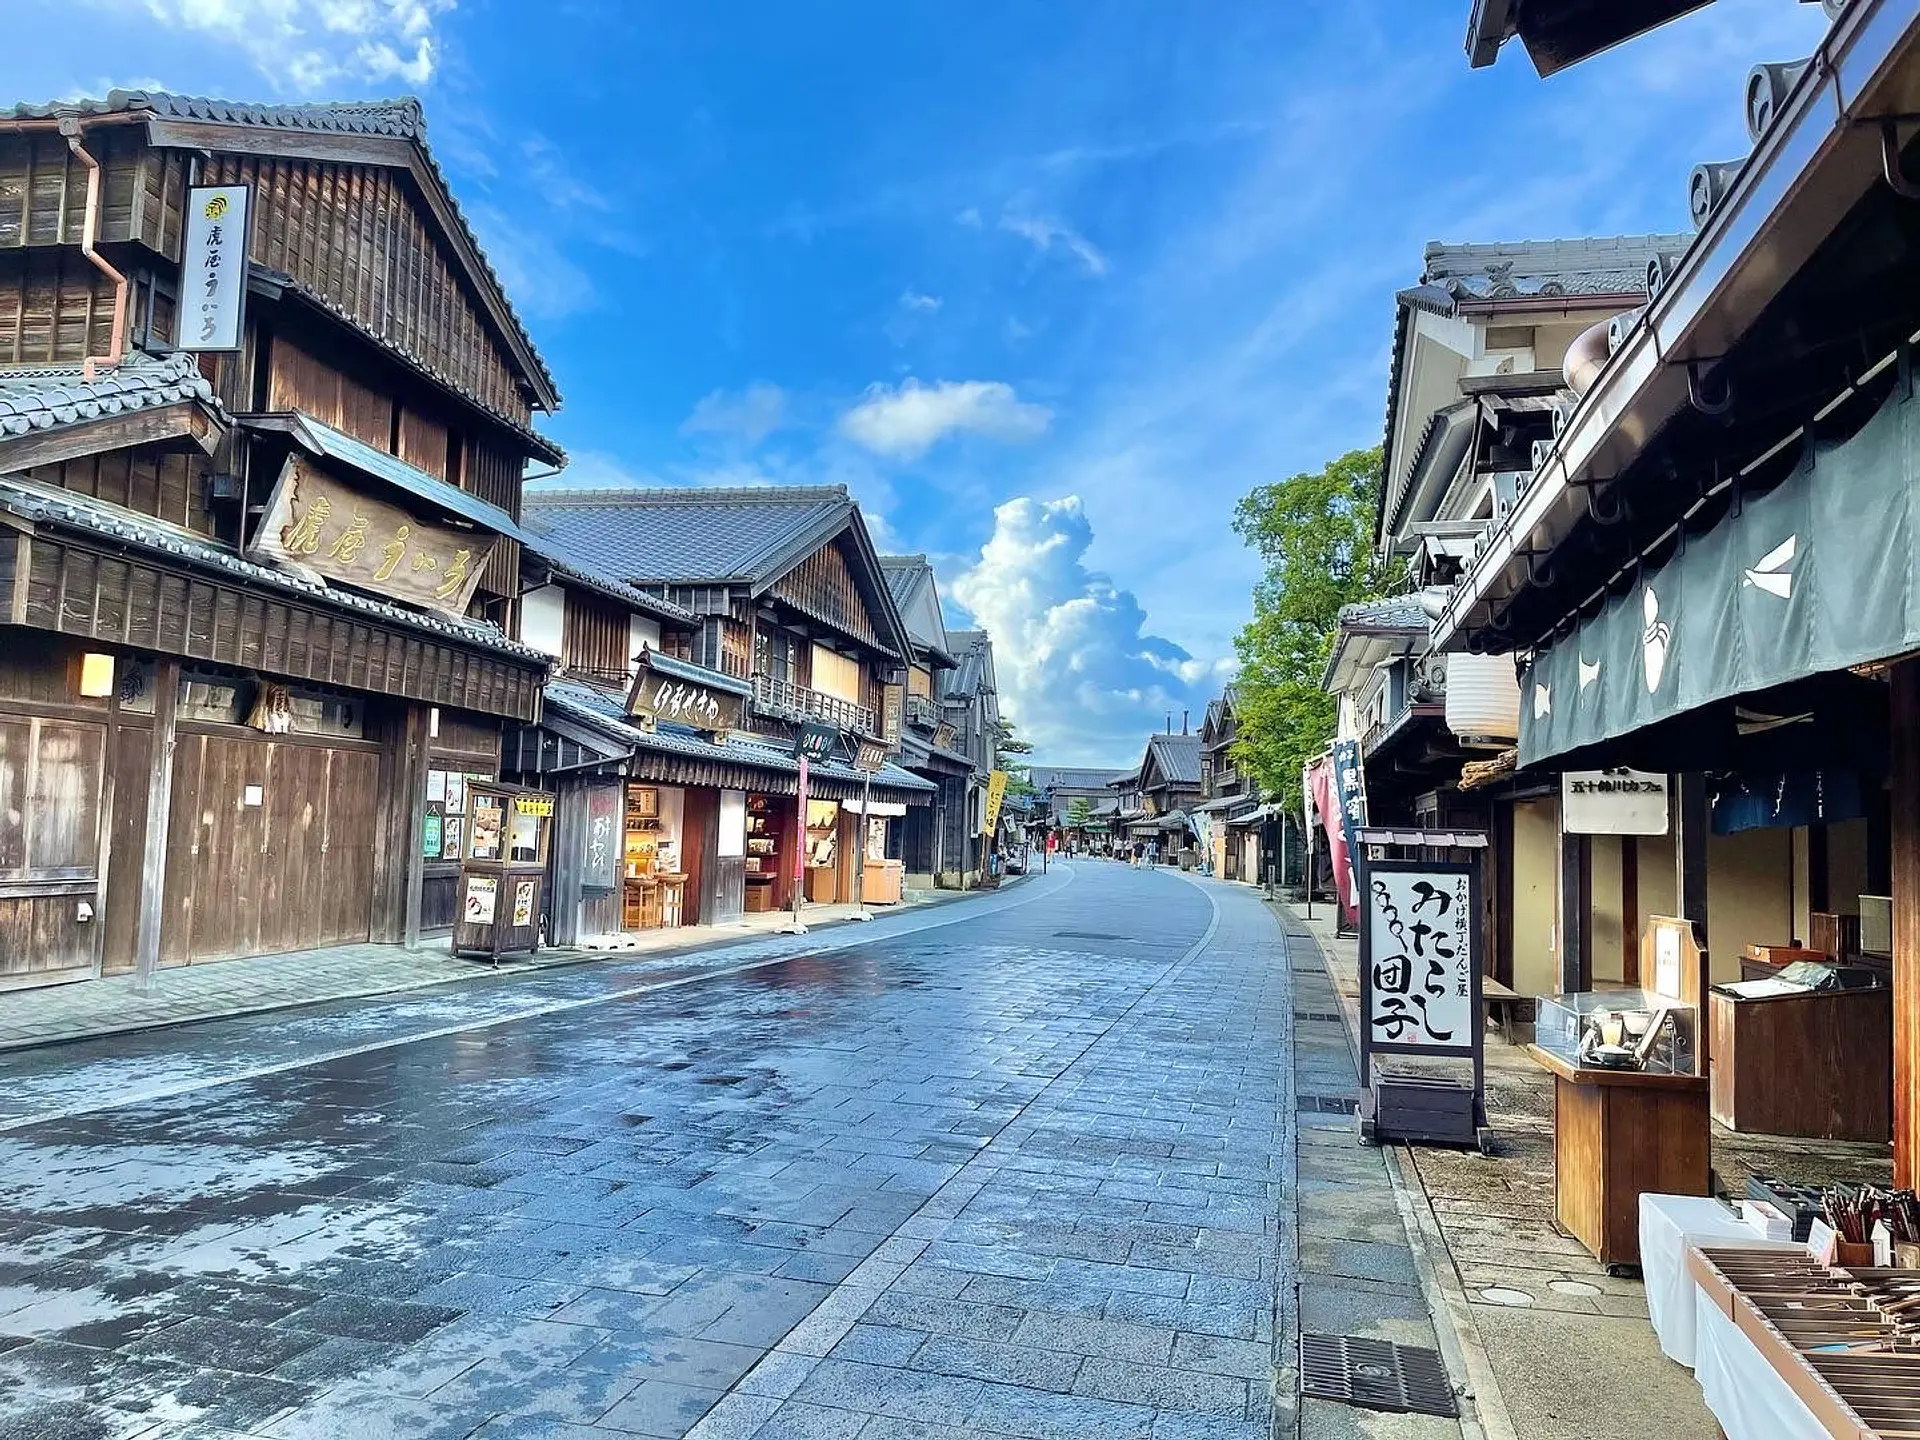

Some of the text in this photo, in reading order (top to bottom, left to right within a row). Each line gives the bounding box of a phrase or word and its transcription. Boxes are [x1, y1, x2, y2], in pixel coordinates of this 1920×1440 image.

[1371, 954, 1419, 1039] 団子
[1408, 881, 1455, 1041] みたらし
[1454, 877, 1469, 998] おかげ横丁だんご屋
